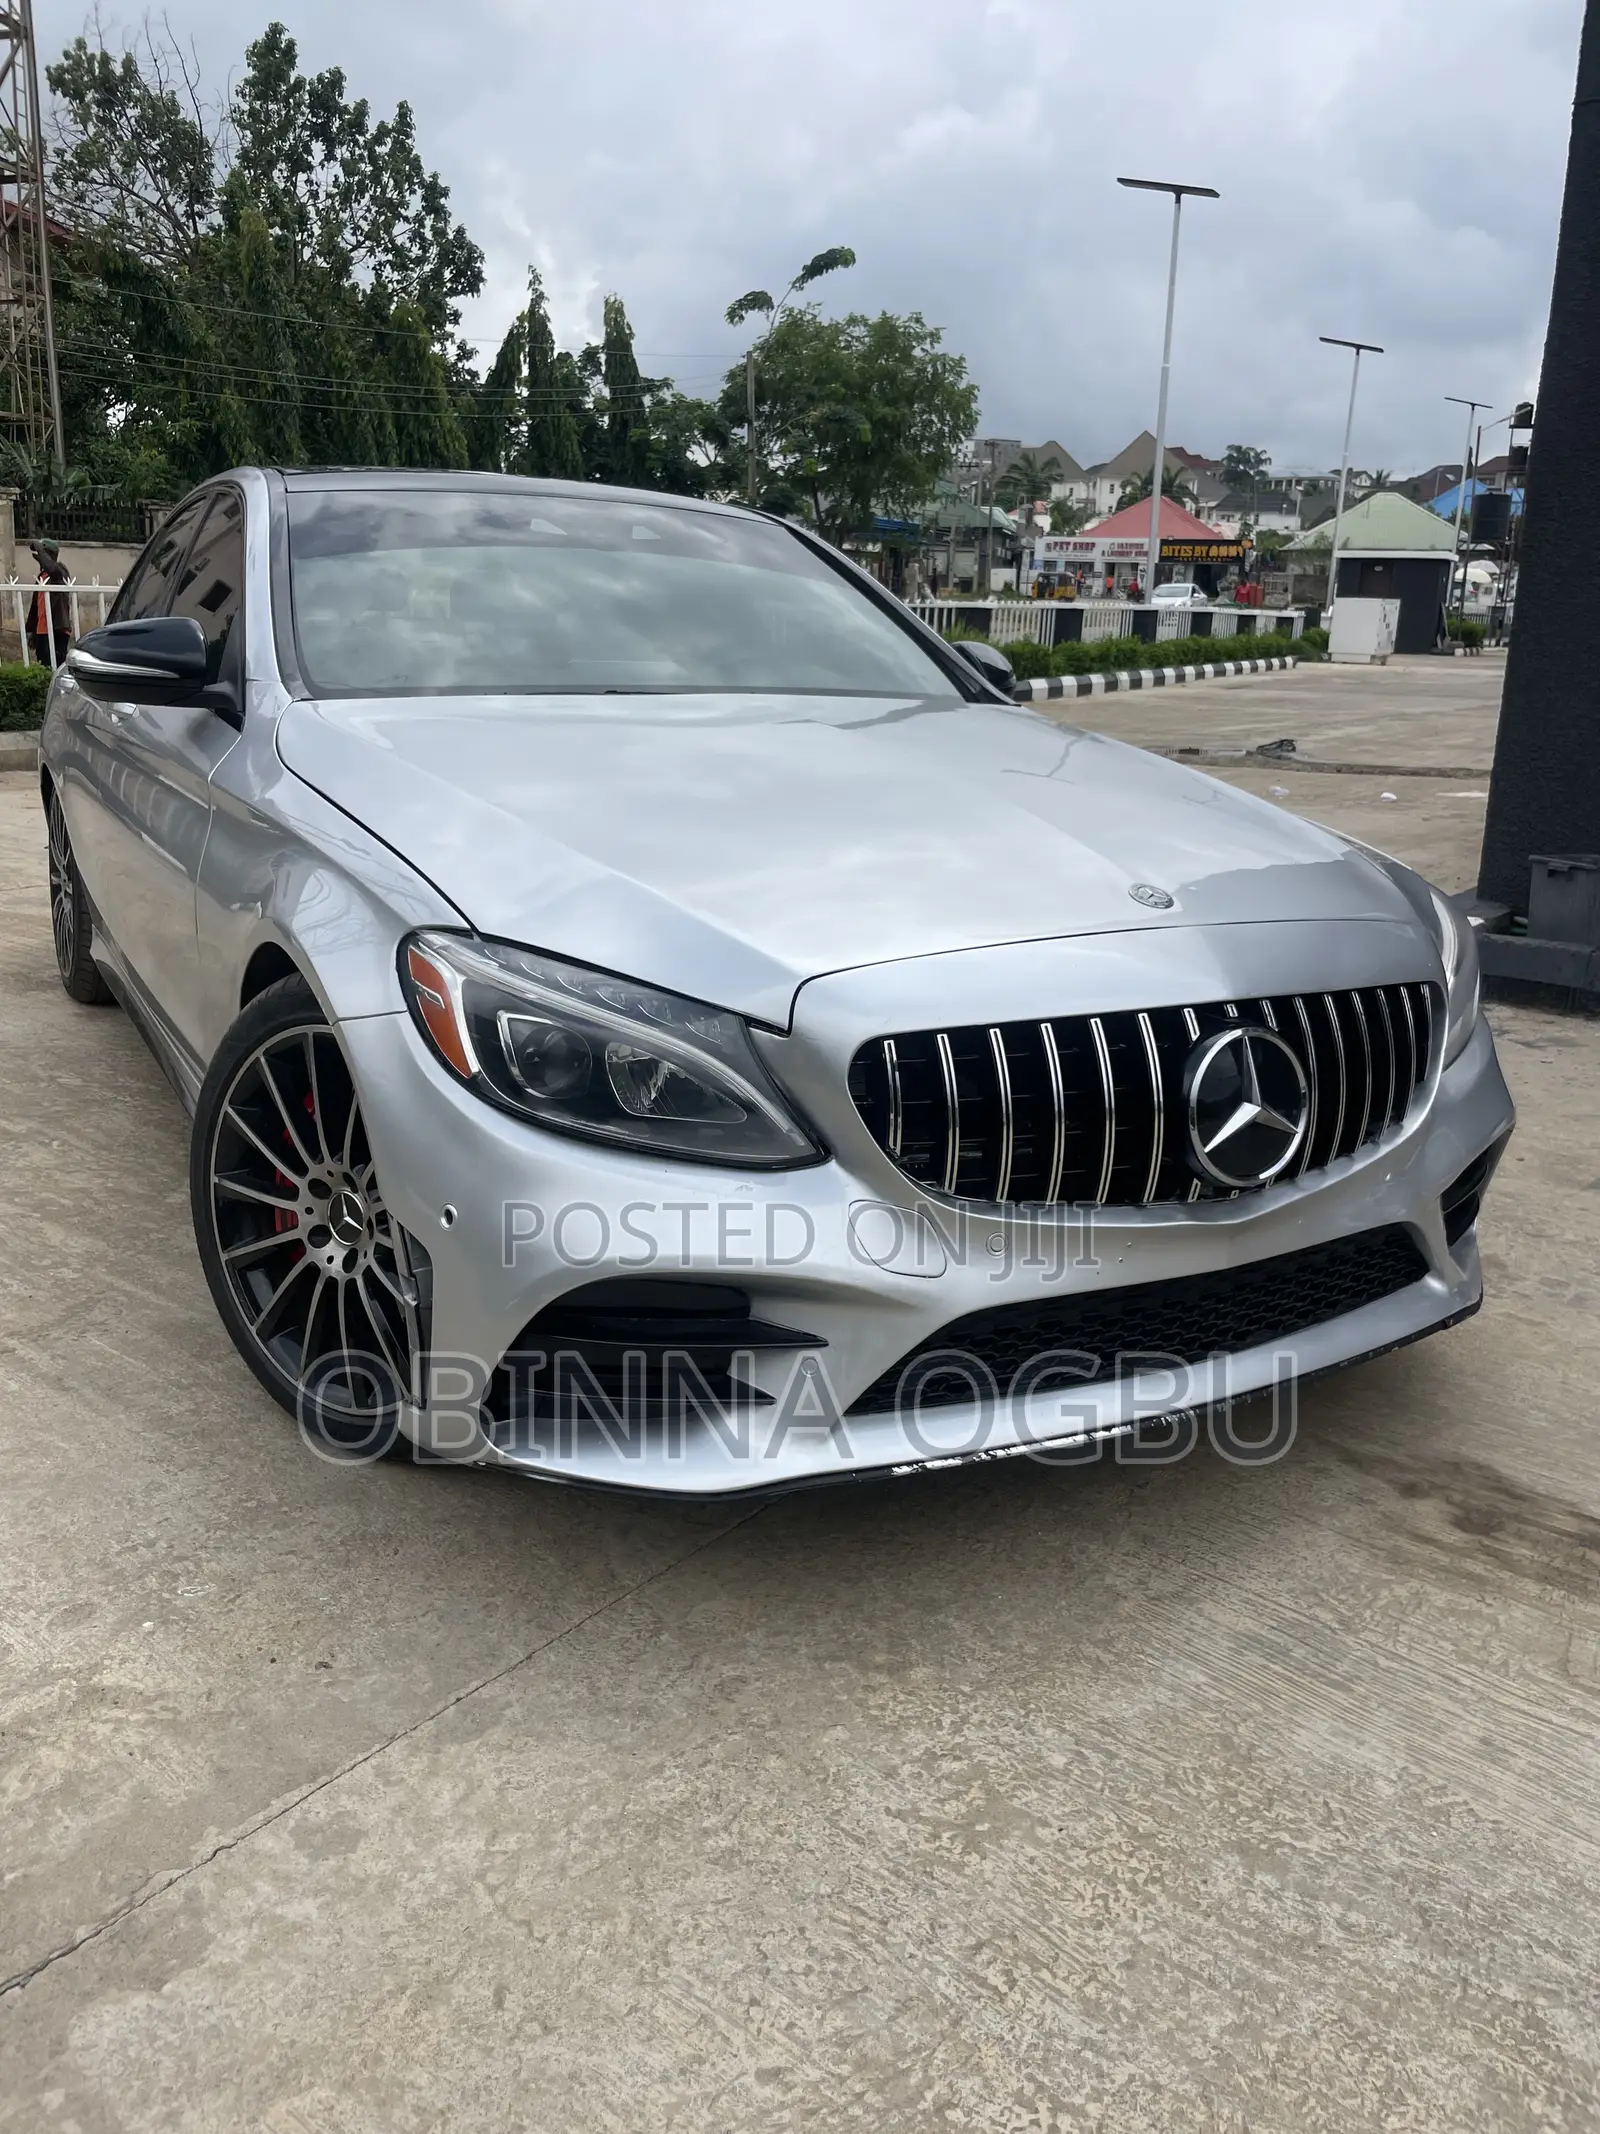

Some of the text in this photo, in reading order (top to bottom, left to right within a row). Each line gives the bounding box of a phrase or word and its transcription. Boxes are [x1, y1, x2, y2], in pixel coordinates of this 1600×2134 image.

[1053, 541, 1096, 551] PET SHOP
[1161, 545, 1193, 557] BITES
[1193, 545, 1209, 557] BY
